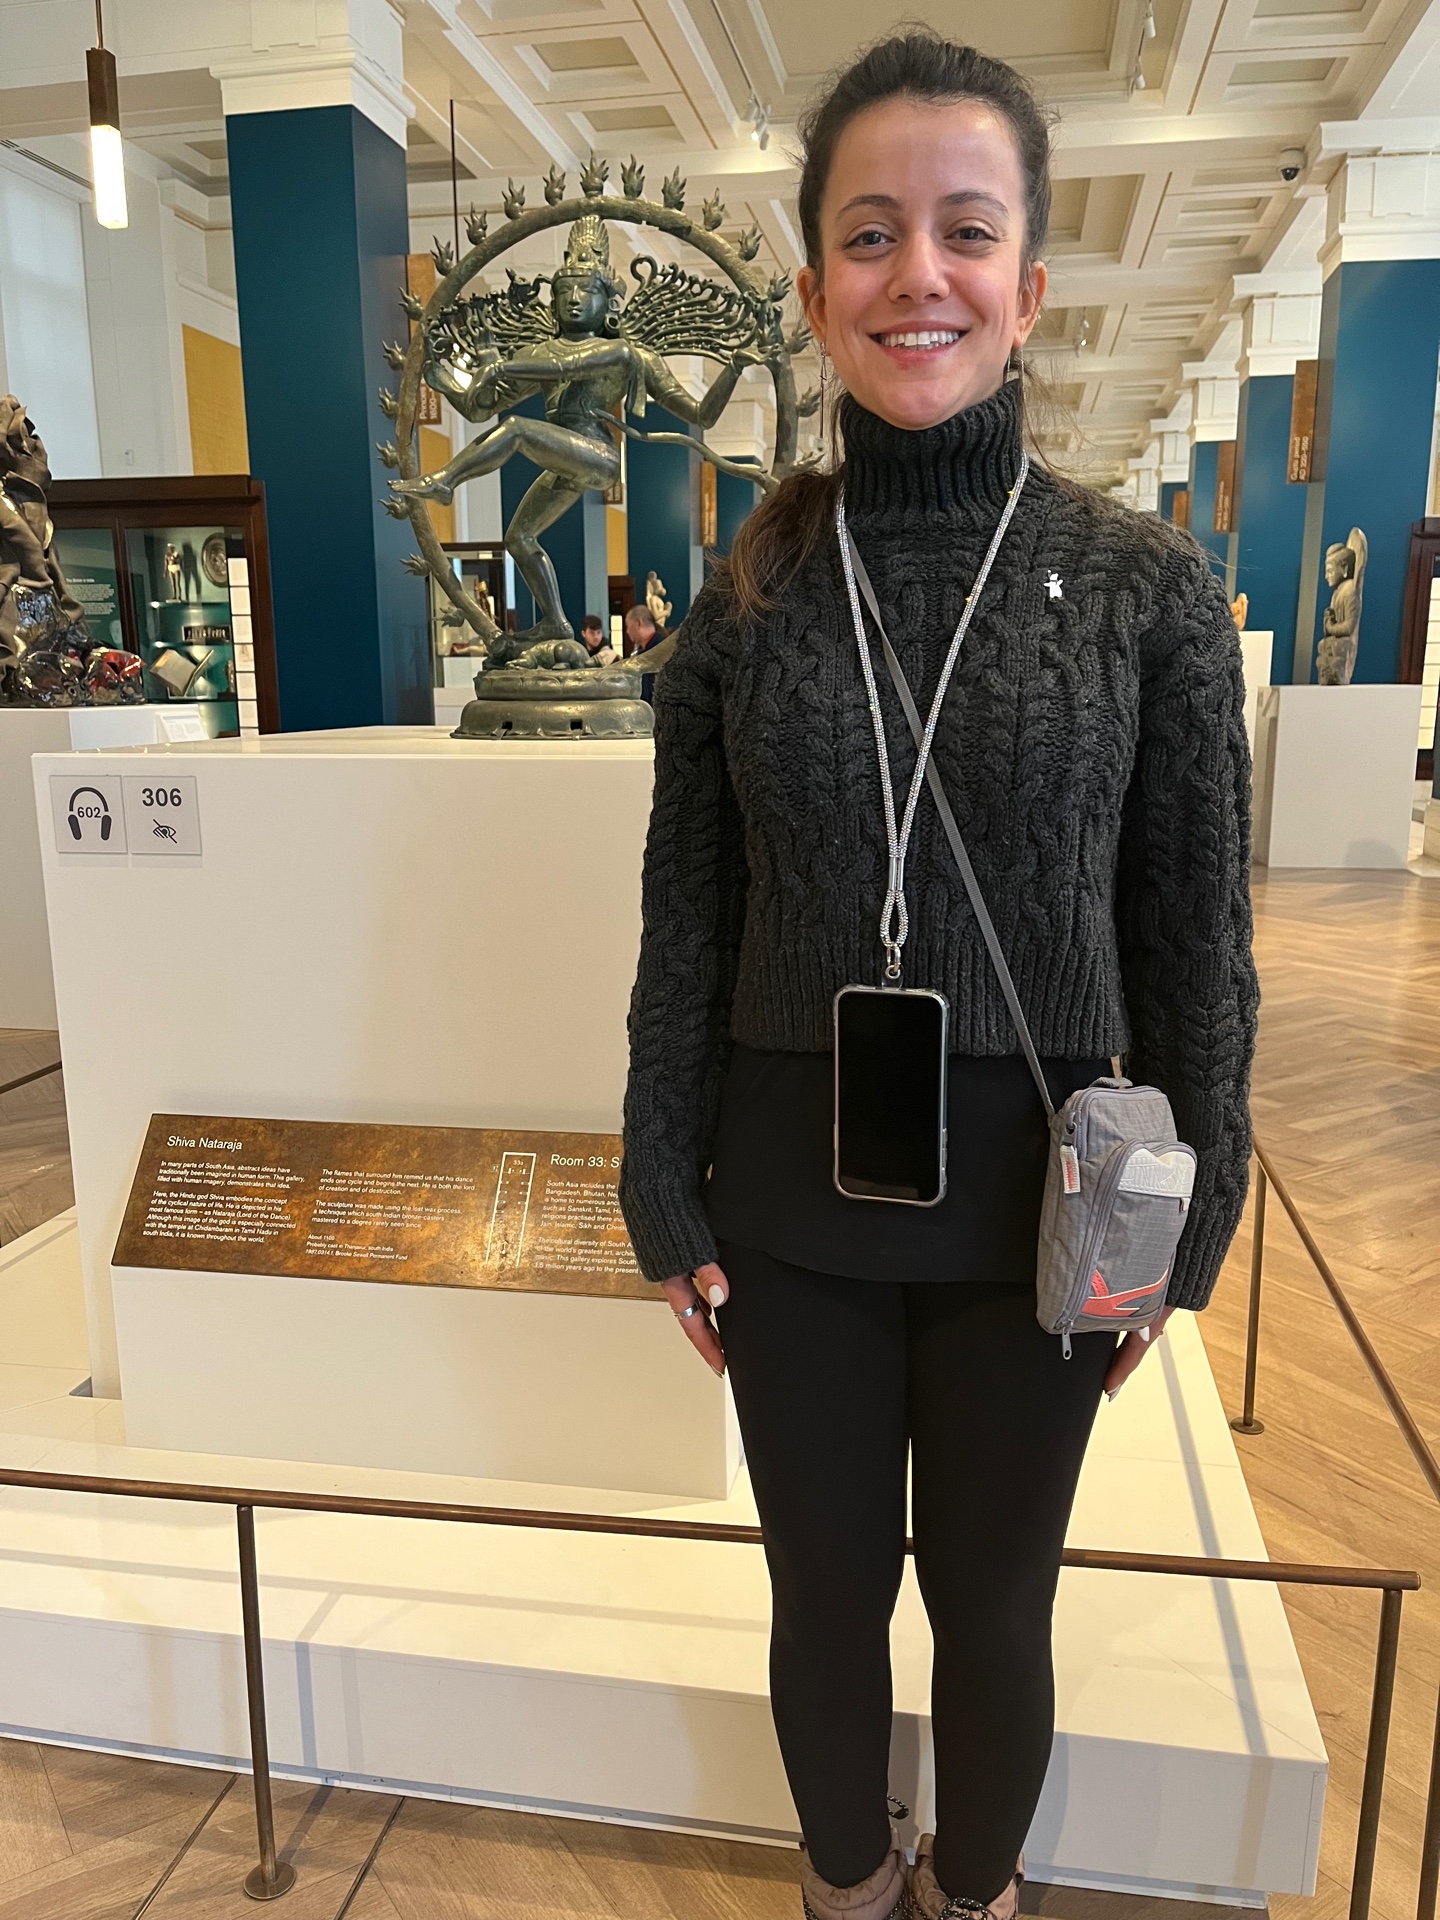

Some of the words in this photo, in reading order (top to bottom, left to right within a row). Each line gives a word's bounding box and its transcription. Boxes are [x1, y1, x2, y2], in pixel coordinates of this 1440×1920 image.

[142, 788, 182, 806] 306
[78, 807, 101, 818] 602
[167, 1136, 196, 1147] Shiva
[198, 1137, 242, 1152] Nataraja
[550, 1154, 584, 1166] Room
[588, 1156, 607, 1167] 33:
[159, 1169, 190, 1177] traditionally
